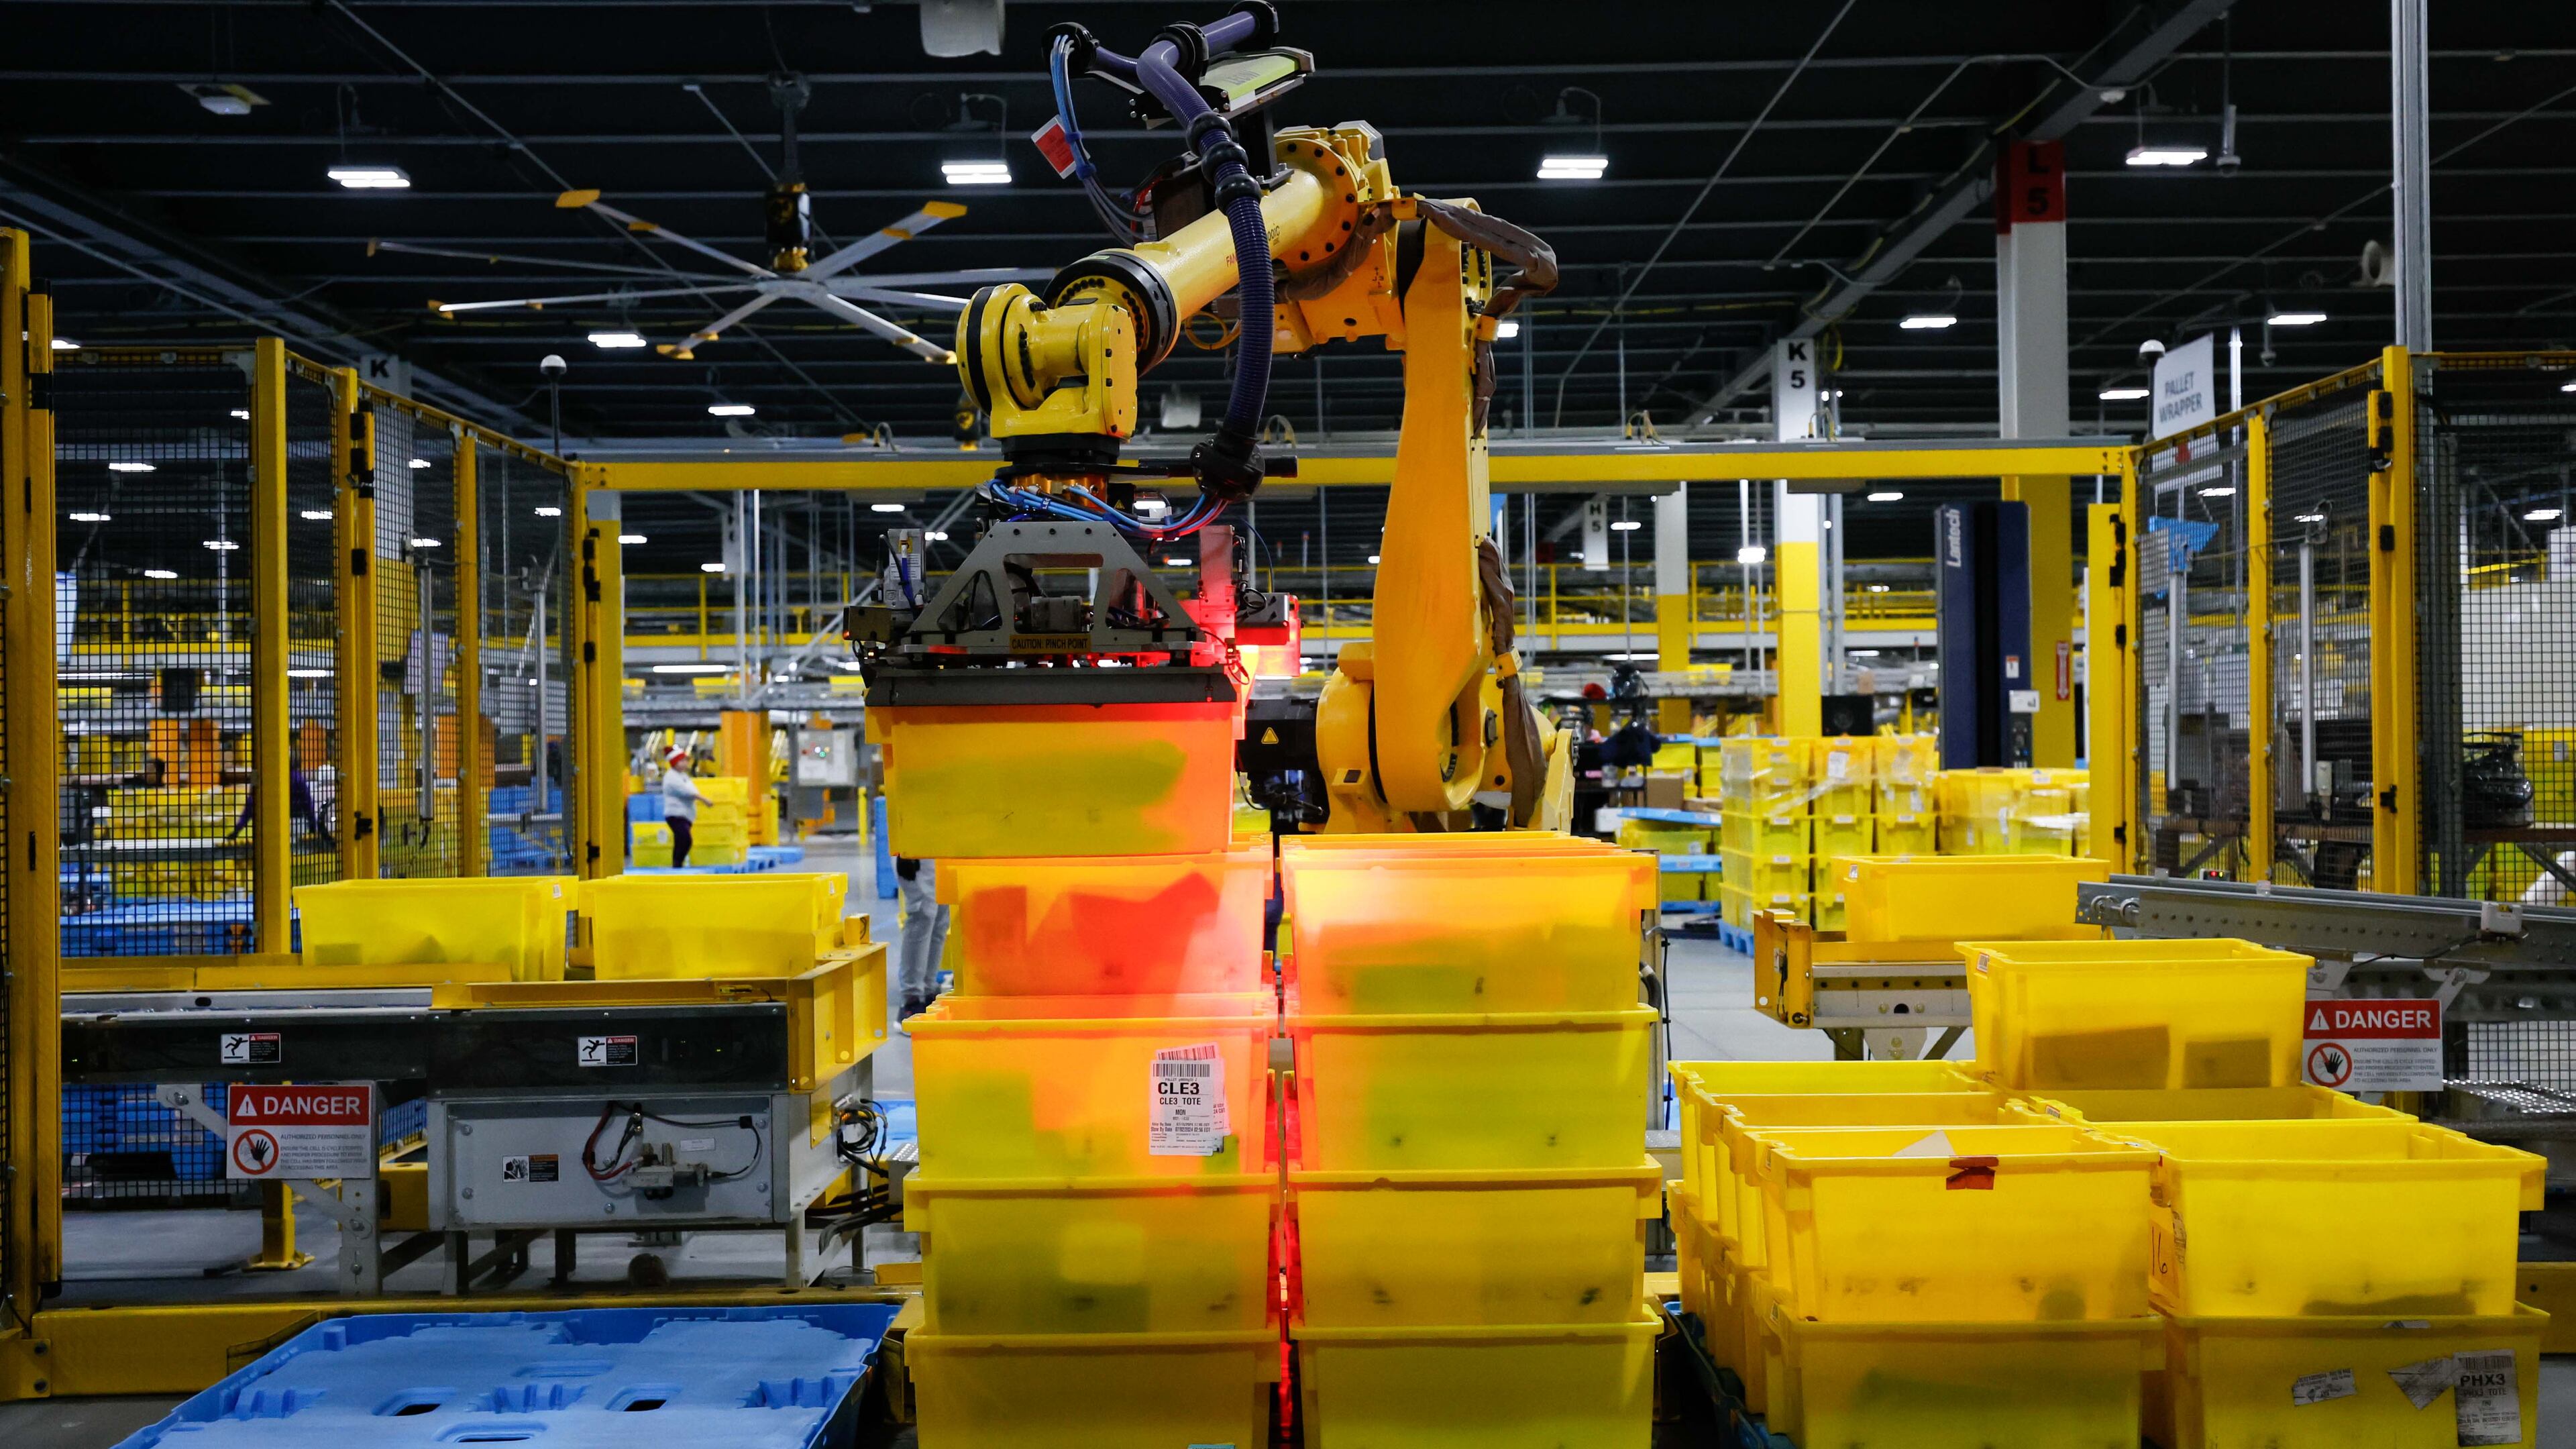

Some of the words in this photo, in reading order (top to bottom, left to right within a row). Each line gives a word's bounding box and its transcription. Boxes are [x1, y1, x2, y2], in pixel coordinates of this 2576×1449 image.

[2028, 146, 2051, 173] L
[2027, 187, 2051, 215] 5
[1226, 252, 1238, 268] FAN
[1788, 342, 1807, 362] K
[370, 360, 389, 378] K
[1791, 370, 1805, 390] 5
[2165, 371, 2195, 398] PALLET
[2159, 392, 2203, 423] WRAPPER
[1590, 503, 1602, 516] H
[1592, 520, 1601, 533] 5
[1945, 508, 1962, 567] Lantech
[1045, 638, 1066, 649] PINCH
[1067, 638, 1088, 649] POINT
[2335, 1010, 2431, 1028] DANGER
[1158, 1081, 1199, 1095] CLE3
[264, 1096, 361, 1115] DANGER
[1160, 1097, 1178, 1106] CLE3
[1183, 1097, 1201, 1106] TOTE
[2151, 1225, 2168, 1276] 16
[2460, 1373, 2506, 1387] PHX3
[2489, 1387, 2508, 1396] TOTE
